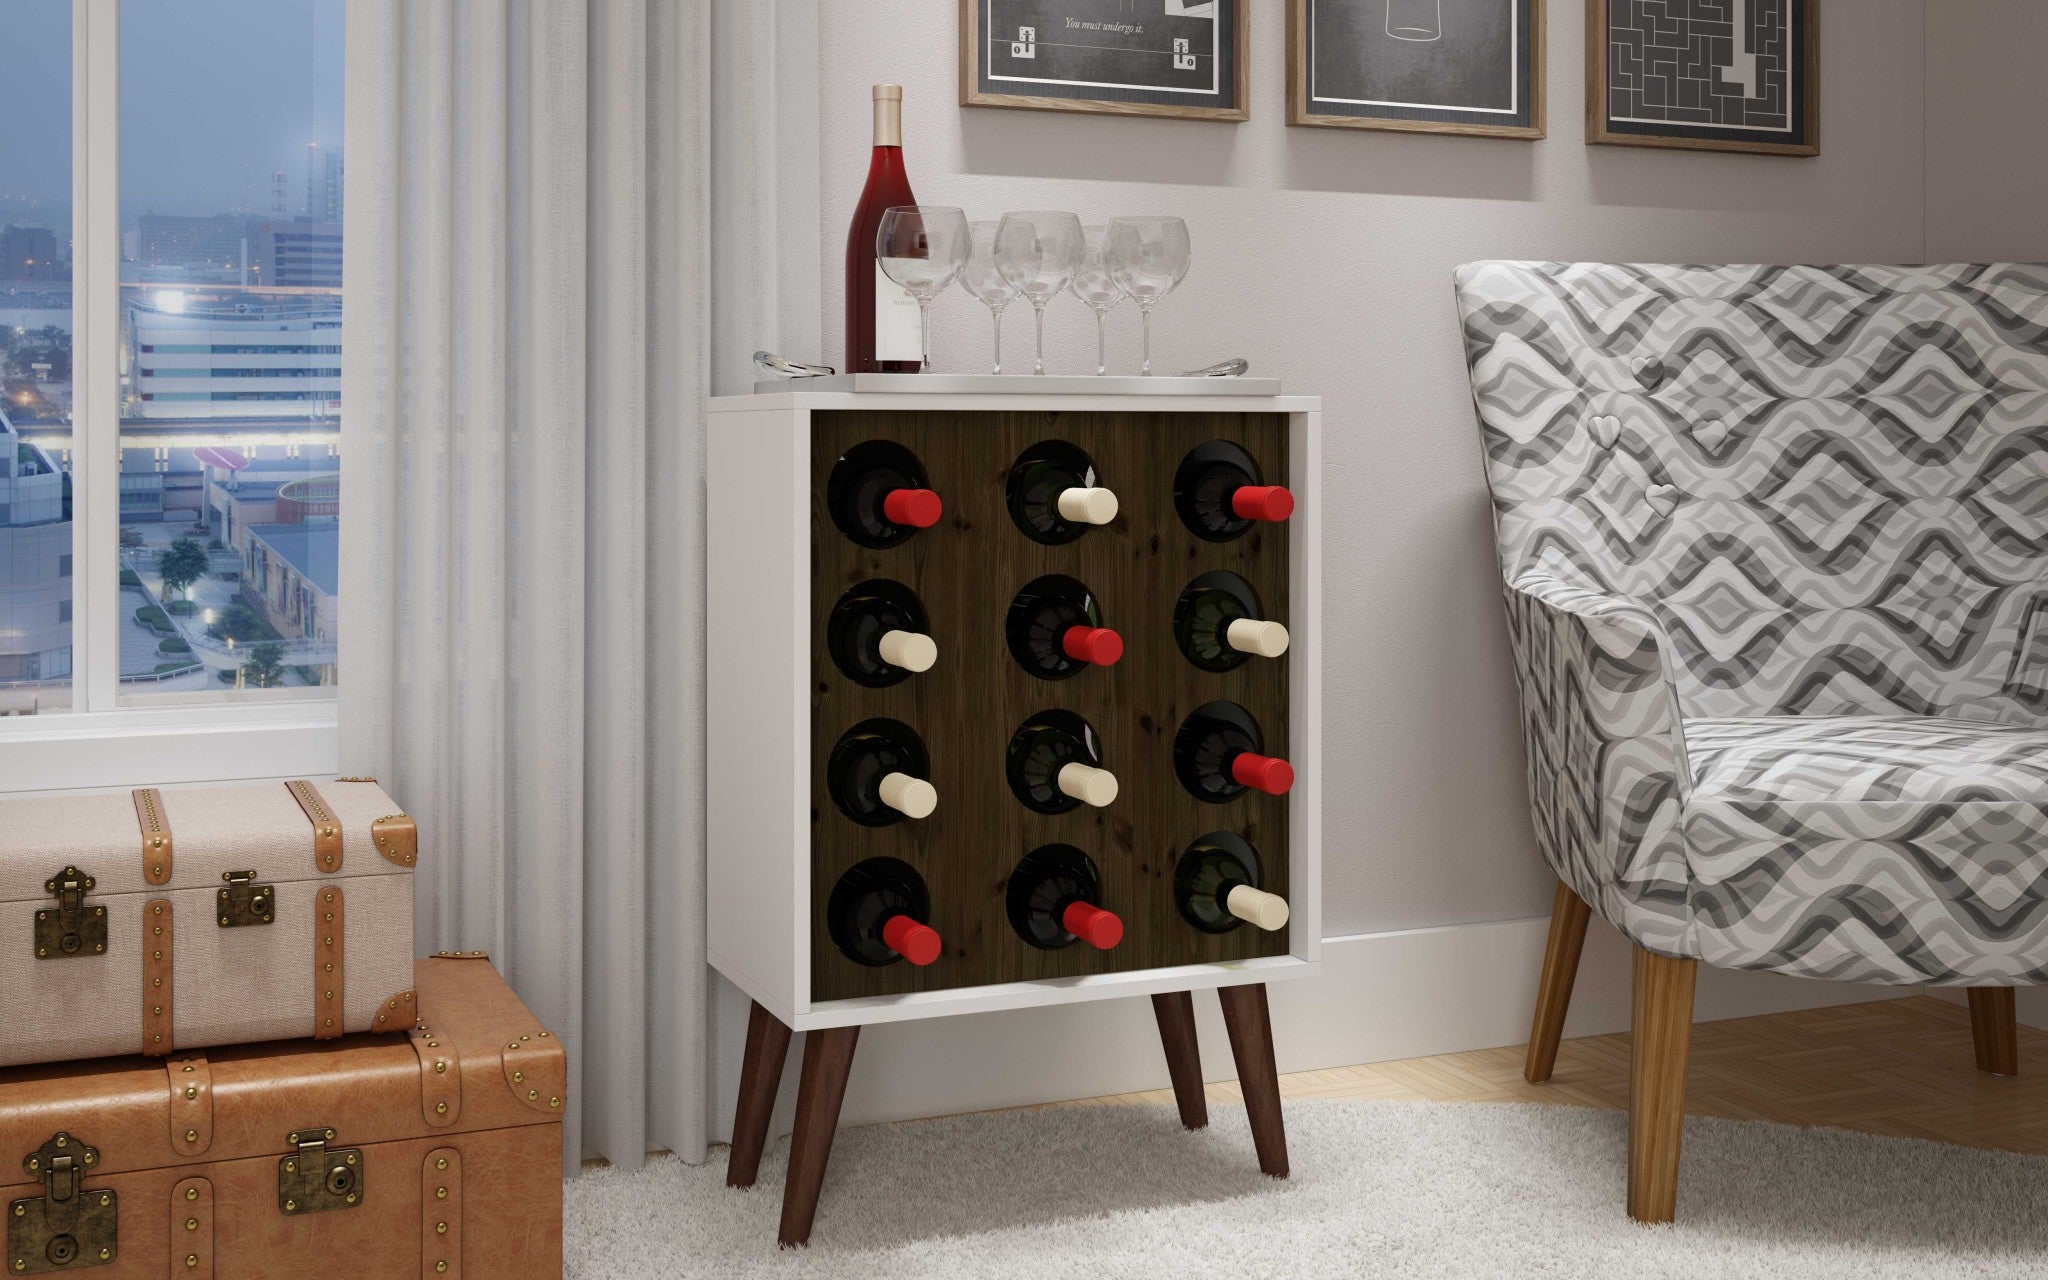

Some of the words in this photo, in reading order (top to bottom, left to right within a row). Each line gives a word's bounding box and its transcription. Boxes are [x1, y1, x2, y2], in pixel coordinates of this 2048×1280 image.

[1065, 17, 1080, 29] You
[1081, 21, 1101, 30] must
[1102, 21, 1134, 35] undergo
[1135, 22, 1144, 34] it.
